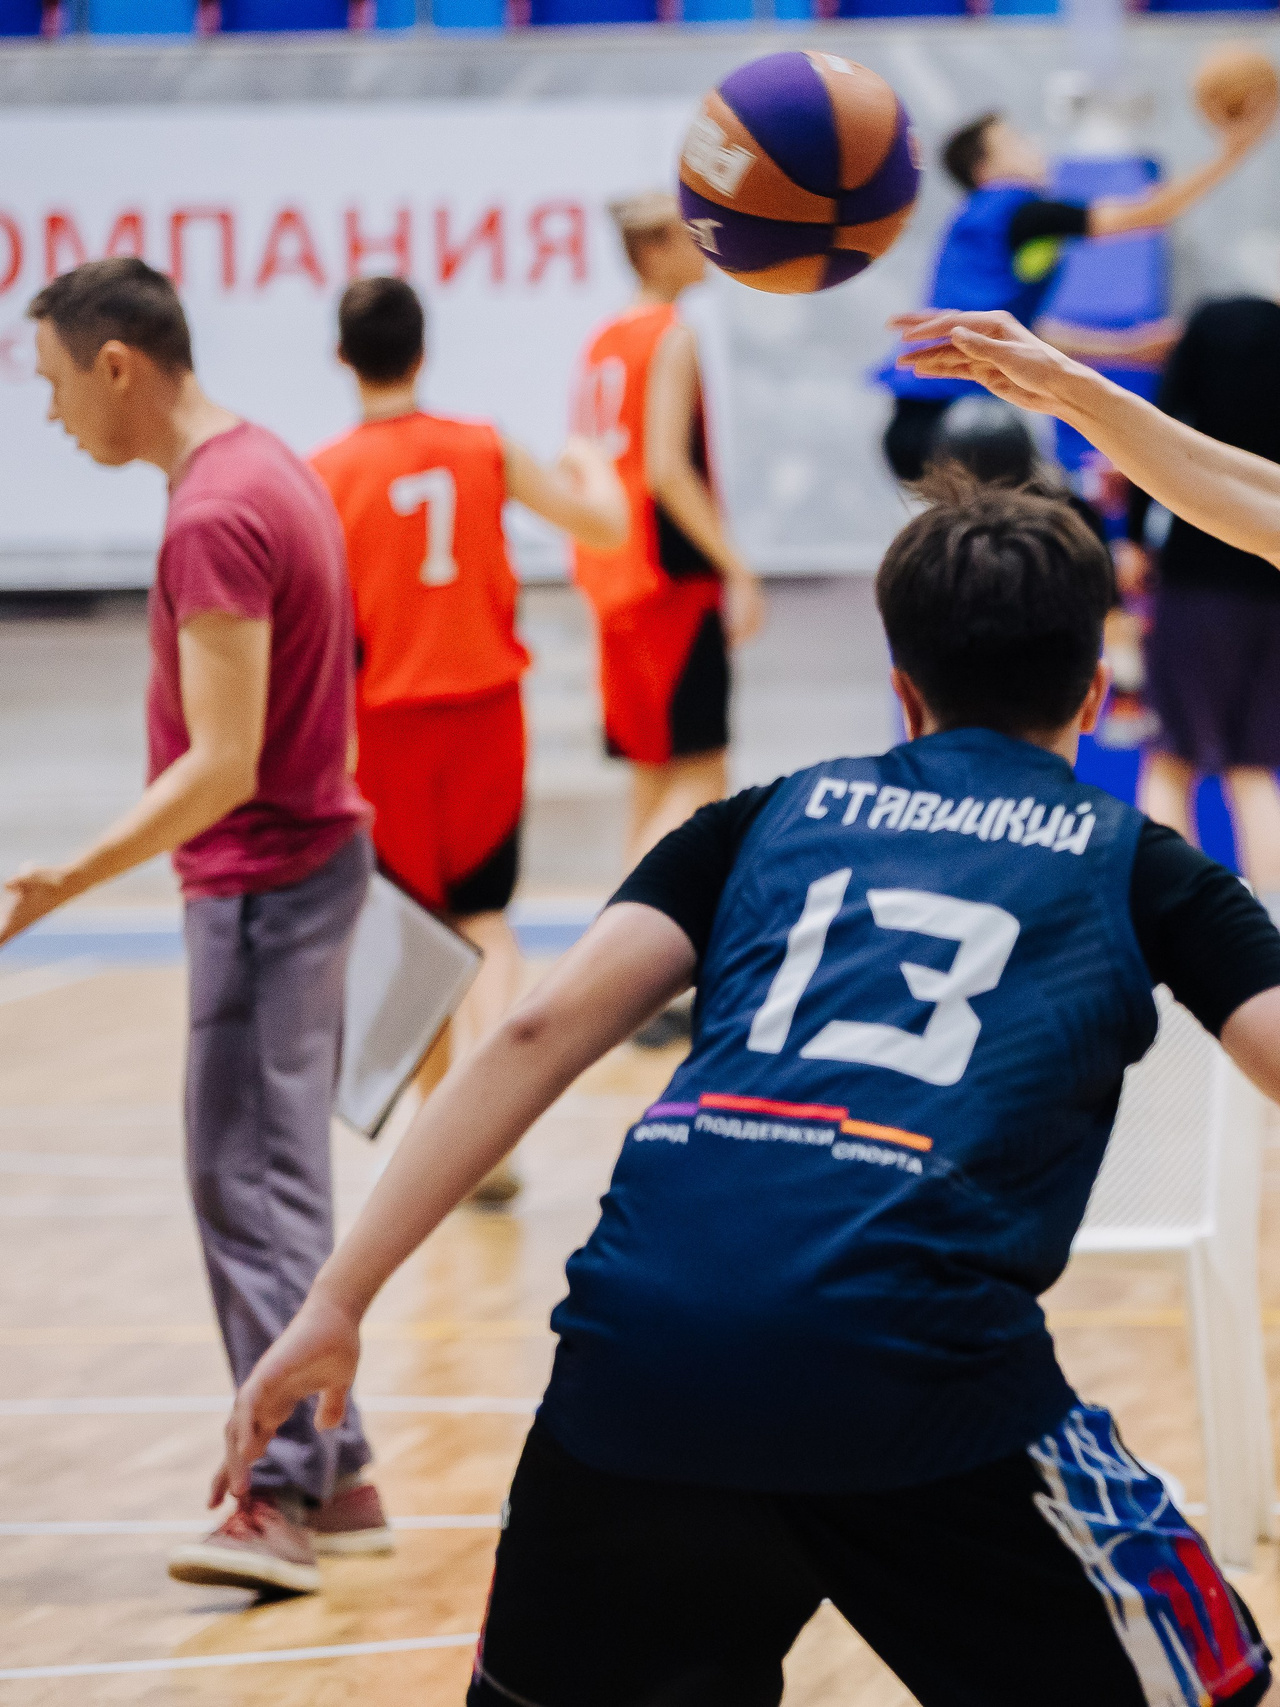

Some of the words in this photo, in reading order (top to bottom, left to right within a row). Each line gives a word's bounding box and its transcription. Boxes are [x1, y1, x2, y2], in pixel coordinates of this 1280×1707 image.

[390, 467, 457, 587] 7
[805, 777, 1096, 855] СТАВИЦКИЙ
[746, 867, 1021, 1087] 13
